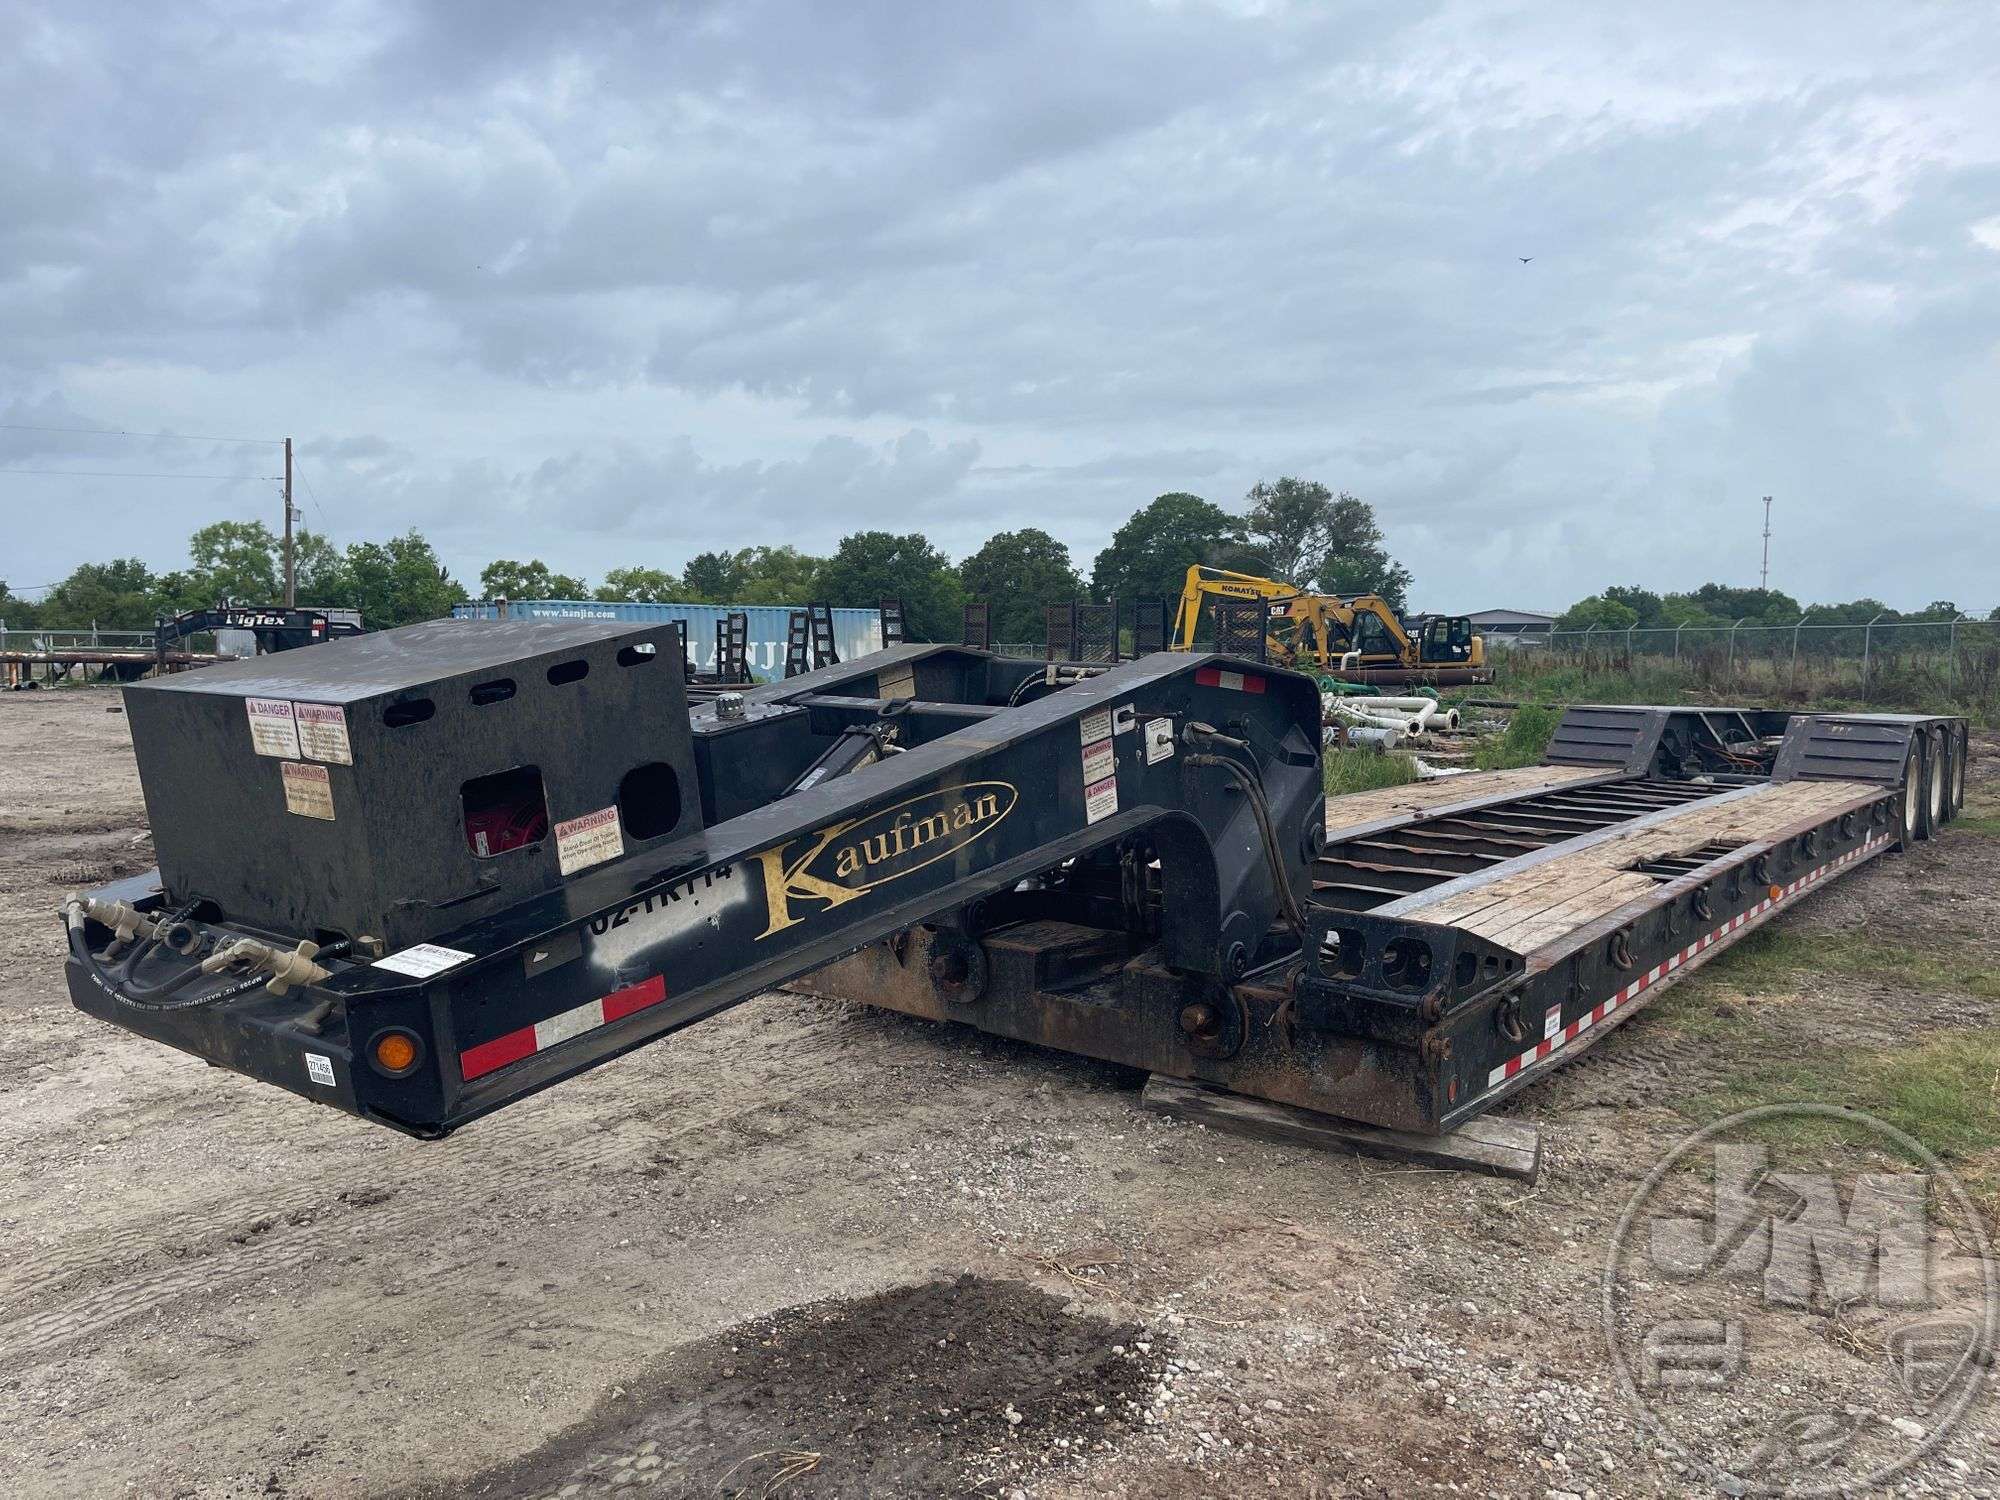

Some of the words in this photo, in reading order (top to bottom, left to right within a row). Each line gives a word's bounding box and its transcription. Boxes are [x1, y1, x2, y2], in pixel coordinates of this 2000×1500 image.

[1222, 585, 1262, 597] KOMATSU
[532, 608, 616, 619] www.hanjin.com
[1270, 606, 1285, 615] CAT
[1407, 630, 1419, 638] CAT
[257, 703, 290, 716] DANGER
[304, 708, 343, 721] WARNING
[289, 764, 327, 779] WARNING
[567, 810, 615, 833] WARNING
[746, 790, 999, 941] Kaufman
